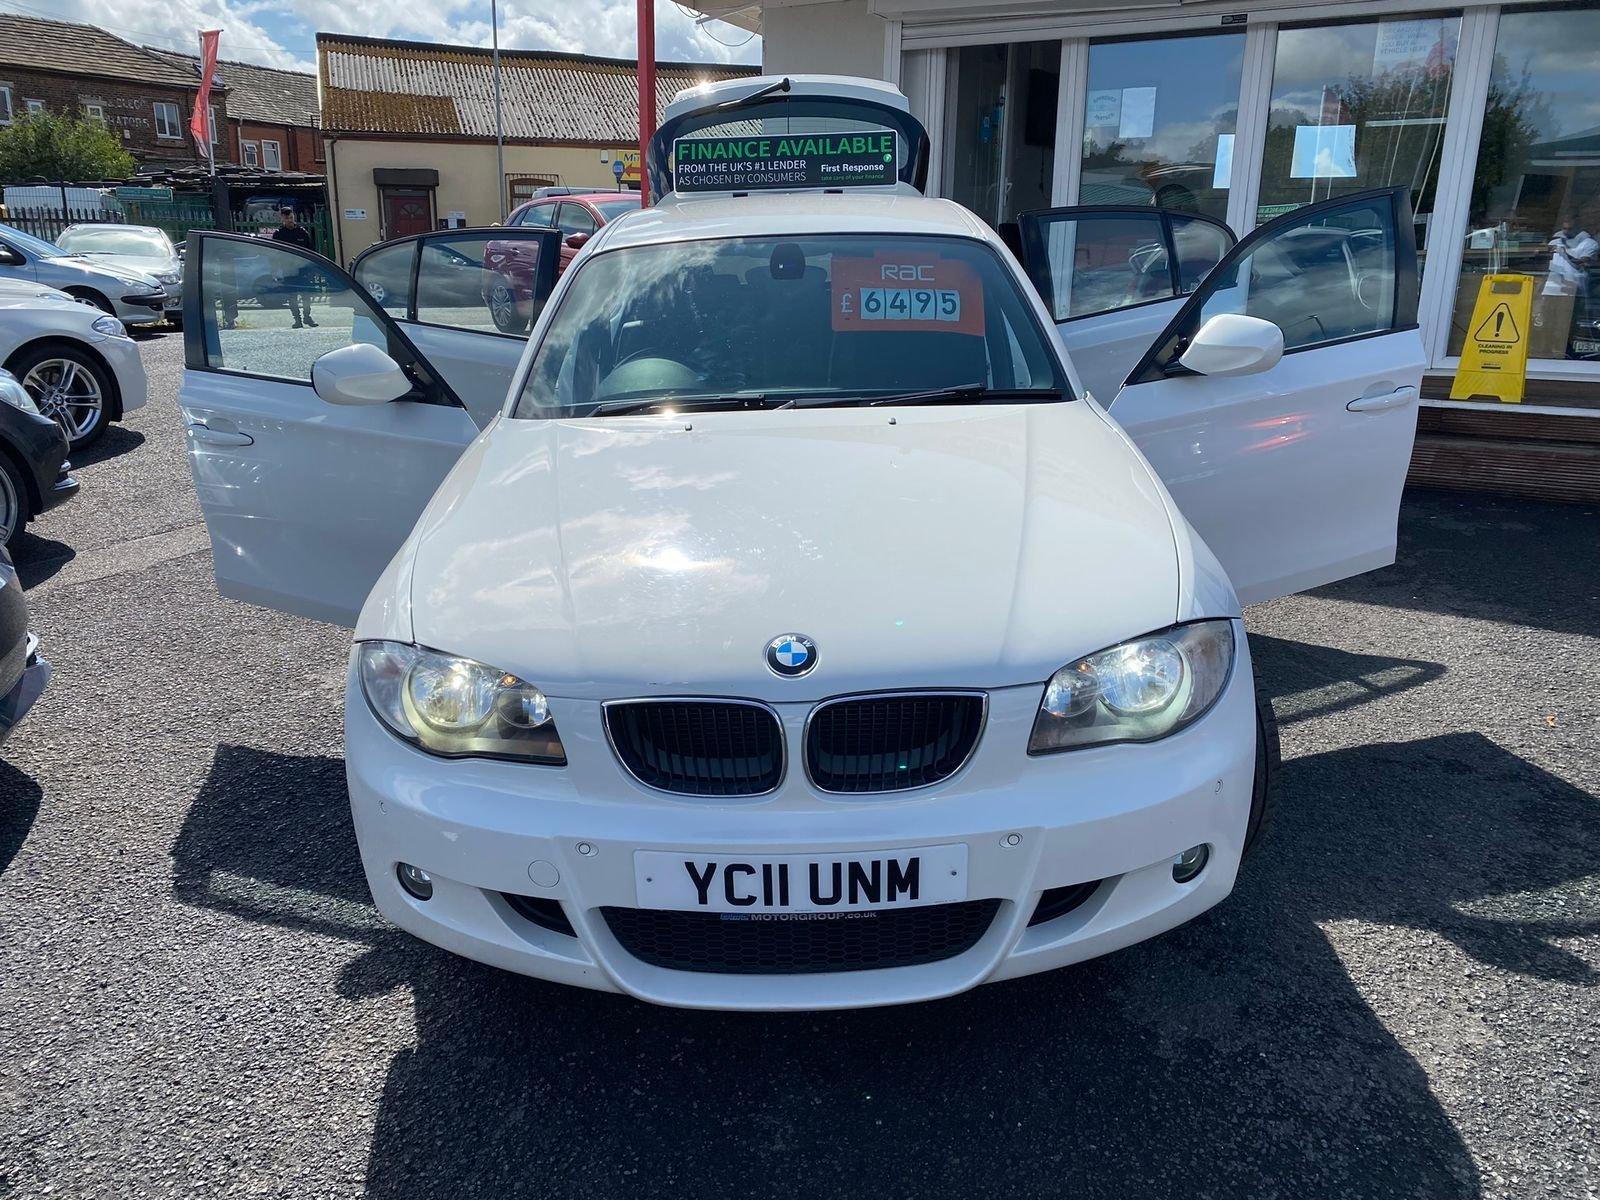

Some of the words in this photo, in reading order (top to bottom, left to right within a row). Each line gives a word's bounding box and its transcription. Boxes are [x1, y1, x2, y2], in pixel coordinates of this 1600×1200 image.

[678, 140, 771, 160] FINANCE
[776, 136, 893, 157] AVAILABLE
[679, 163, 706, 173] FROM
[708, 163, 728, 172] THE
[730, 161, 753, 171] UK'S
[754, 161, 766, 171] #1
[768, 159, 807, 171] LENDER
[821, 164, 840, 173] First
[842, 163, 884, 173] Response
[678, 175, 691, 185] AS
[692, 174, 732, 185] CHOSEN
[734, 173, 746, 183] BY
[747, 171, 807, 184] CONSUMERS
[864, 291, 957, 315] 6495
[771, 634, 814, 649] BMW
[684, 860, 790, 907] YC11
[808, 856, 920, 906] UNM
